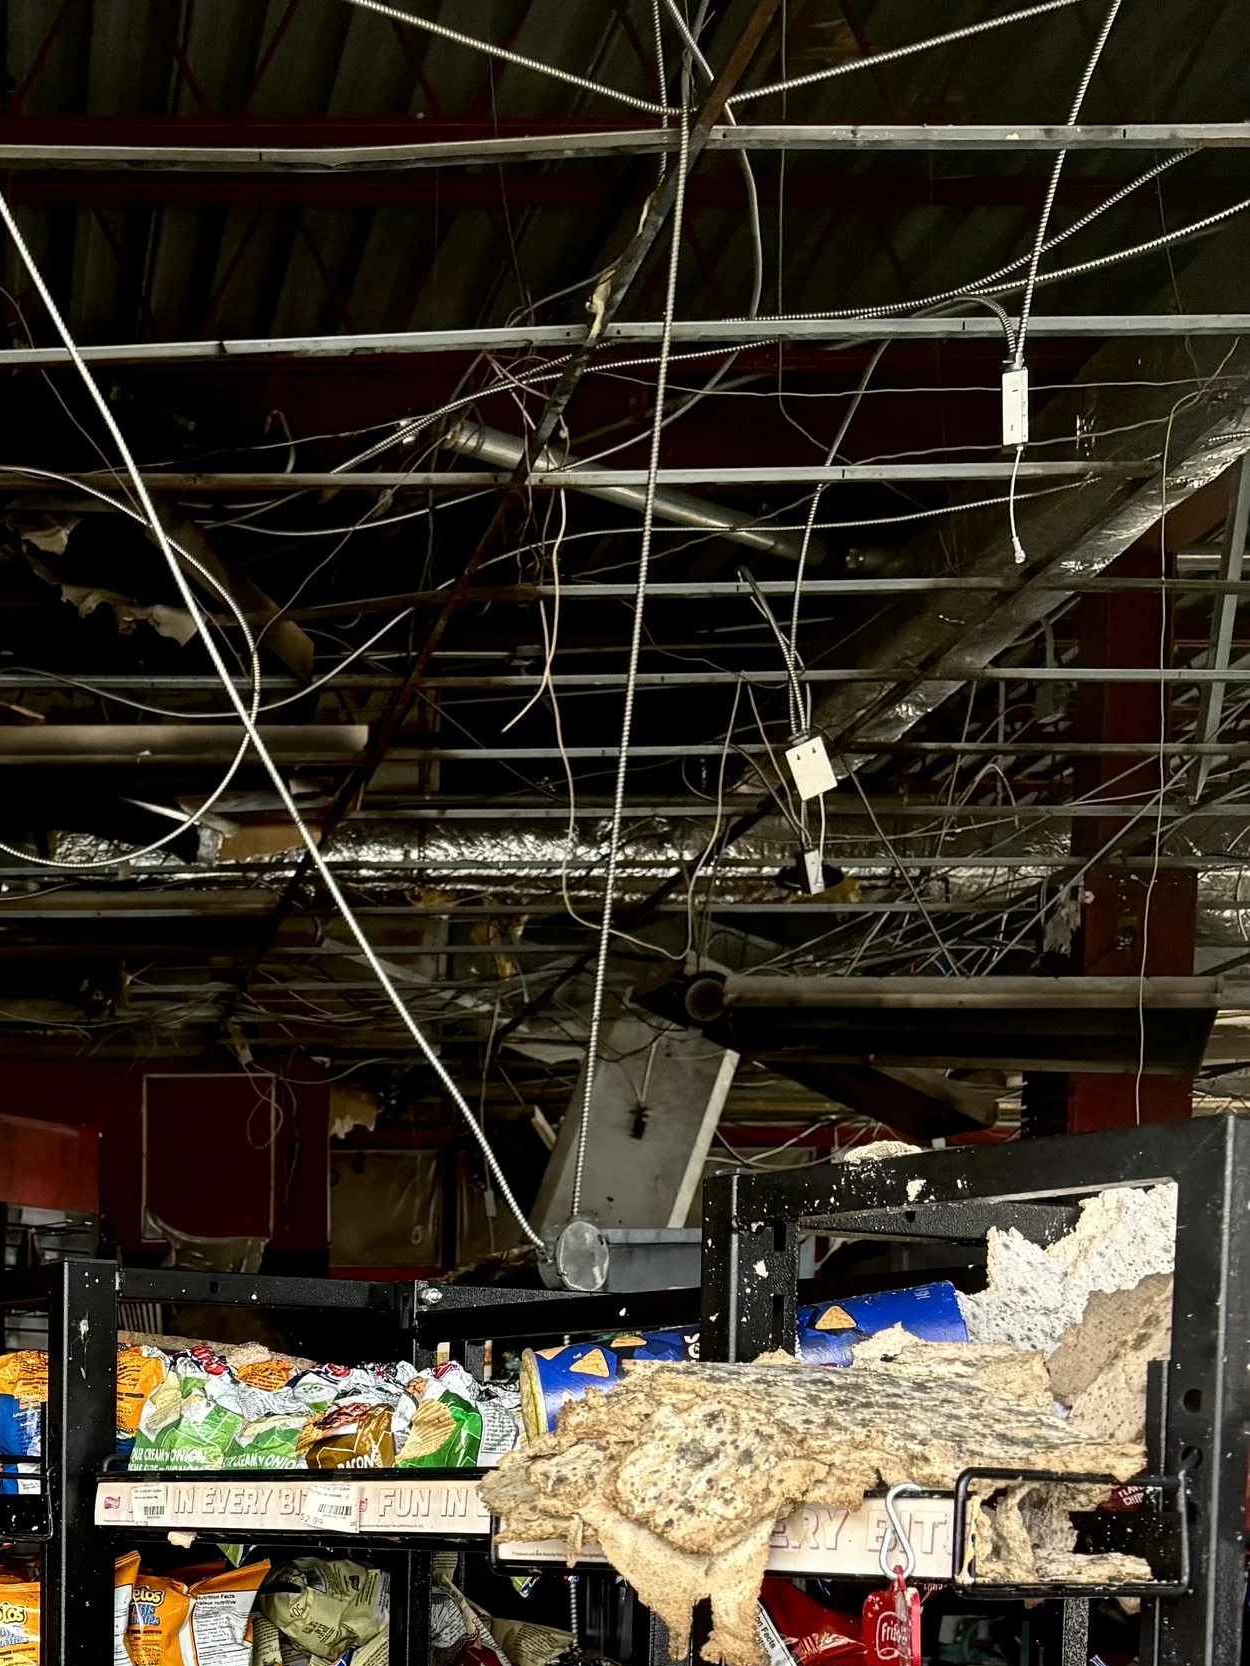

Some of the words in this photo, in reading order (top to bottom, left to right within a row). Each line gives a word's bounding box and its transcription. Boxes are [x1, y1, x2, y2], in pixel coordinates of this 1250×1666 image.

[175, 1488, 195, 1514] IN
[202, 1488, 273, 1515] EVERY
[280, 1488, 304, 1515] BI
[379, 1488, 430, 1517] FUN
[440, 1488, 461, 1517] IN
[770, 1508, 849, 1550] ERY
[867, 1509, 953, 1554] BIT
